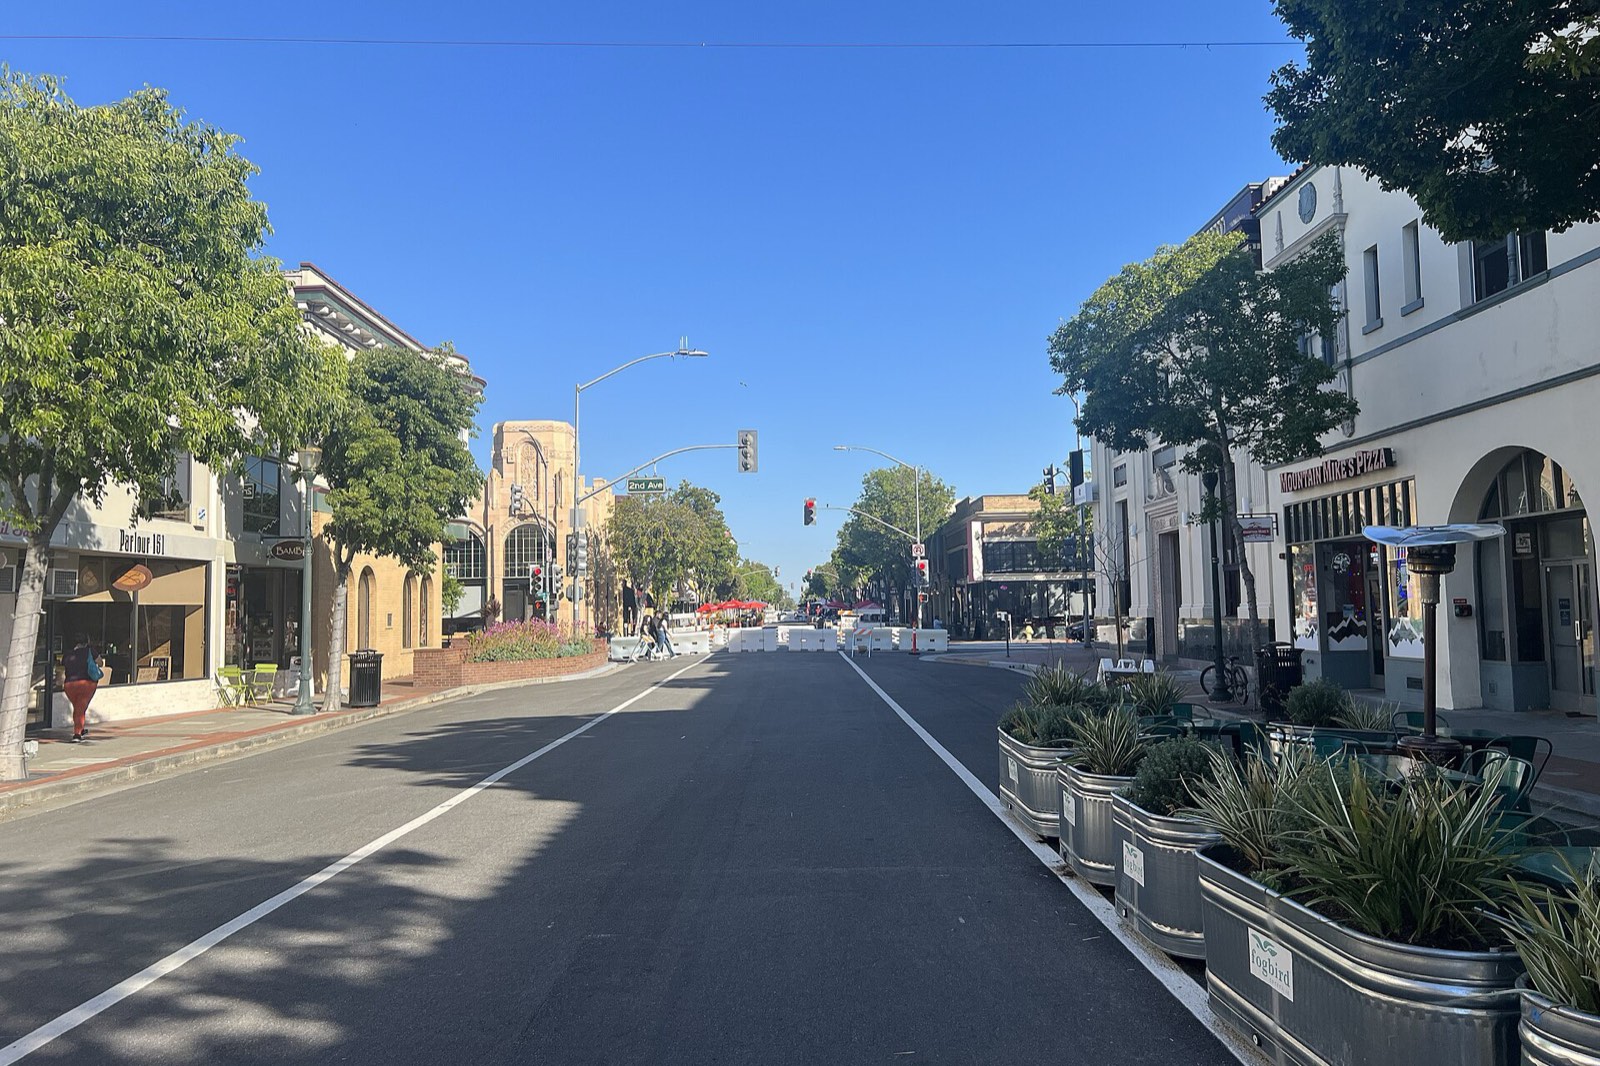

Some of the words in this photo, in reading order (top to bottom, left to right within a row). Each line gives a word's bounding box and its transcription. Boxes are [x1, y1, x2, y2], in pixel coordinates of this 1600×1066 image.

[1280, 466, 1321, 493] MOUNTAIN
[1322, 459, 1355, 483] MIKE'S
[1356, 448, 1387, 475] PIZZA
[629, 481, 645, 490] 2nd
[648, 481, 663, 490] Ave
[119, 529, 150, 554] Parlour
[276, 546, 305, 557] BAMB
[1251, 948, 1291, 988] fogbird
